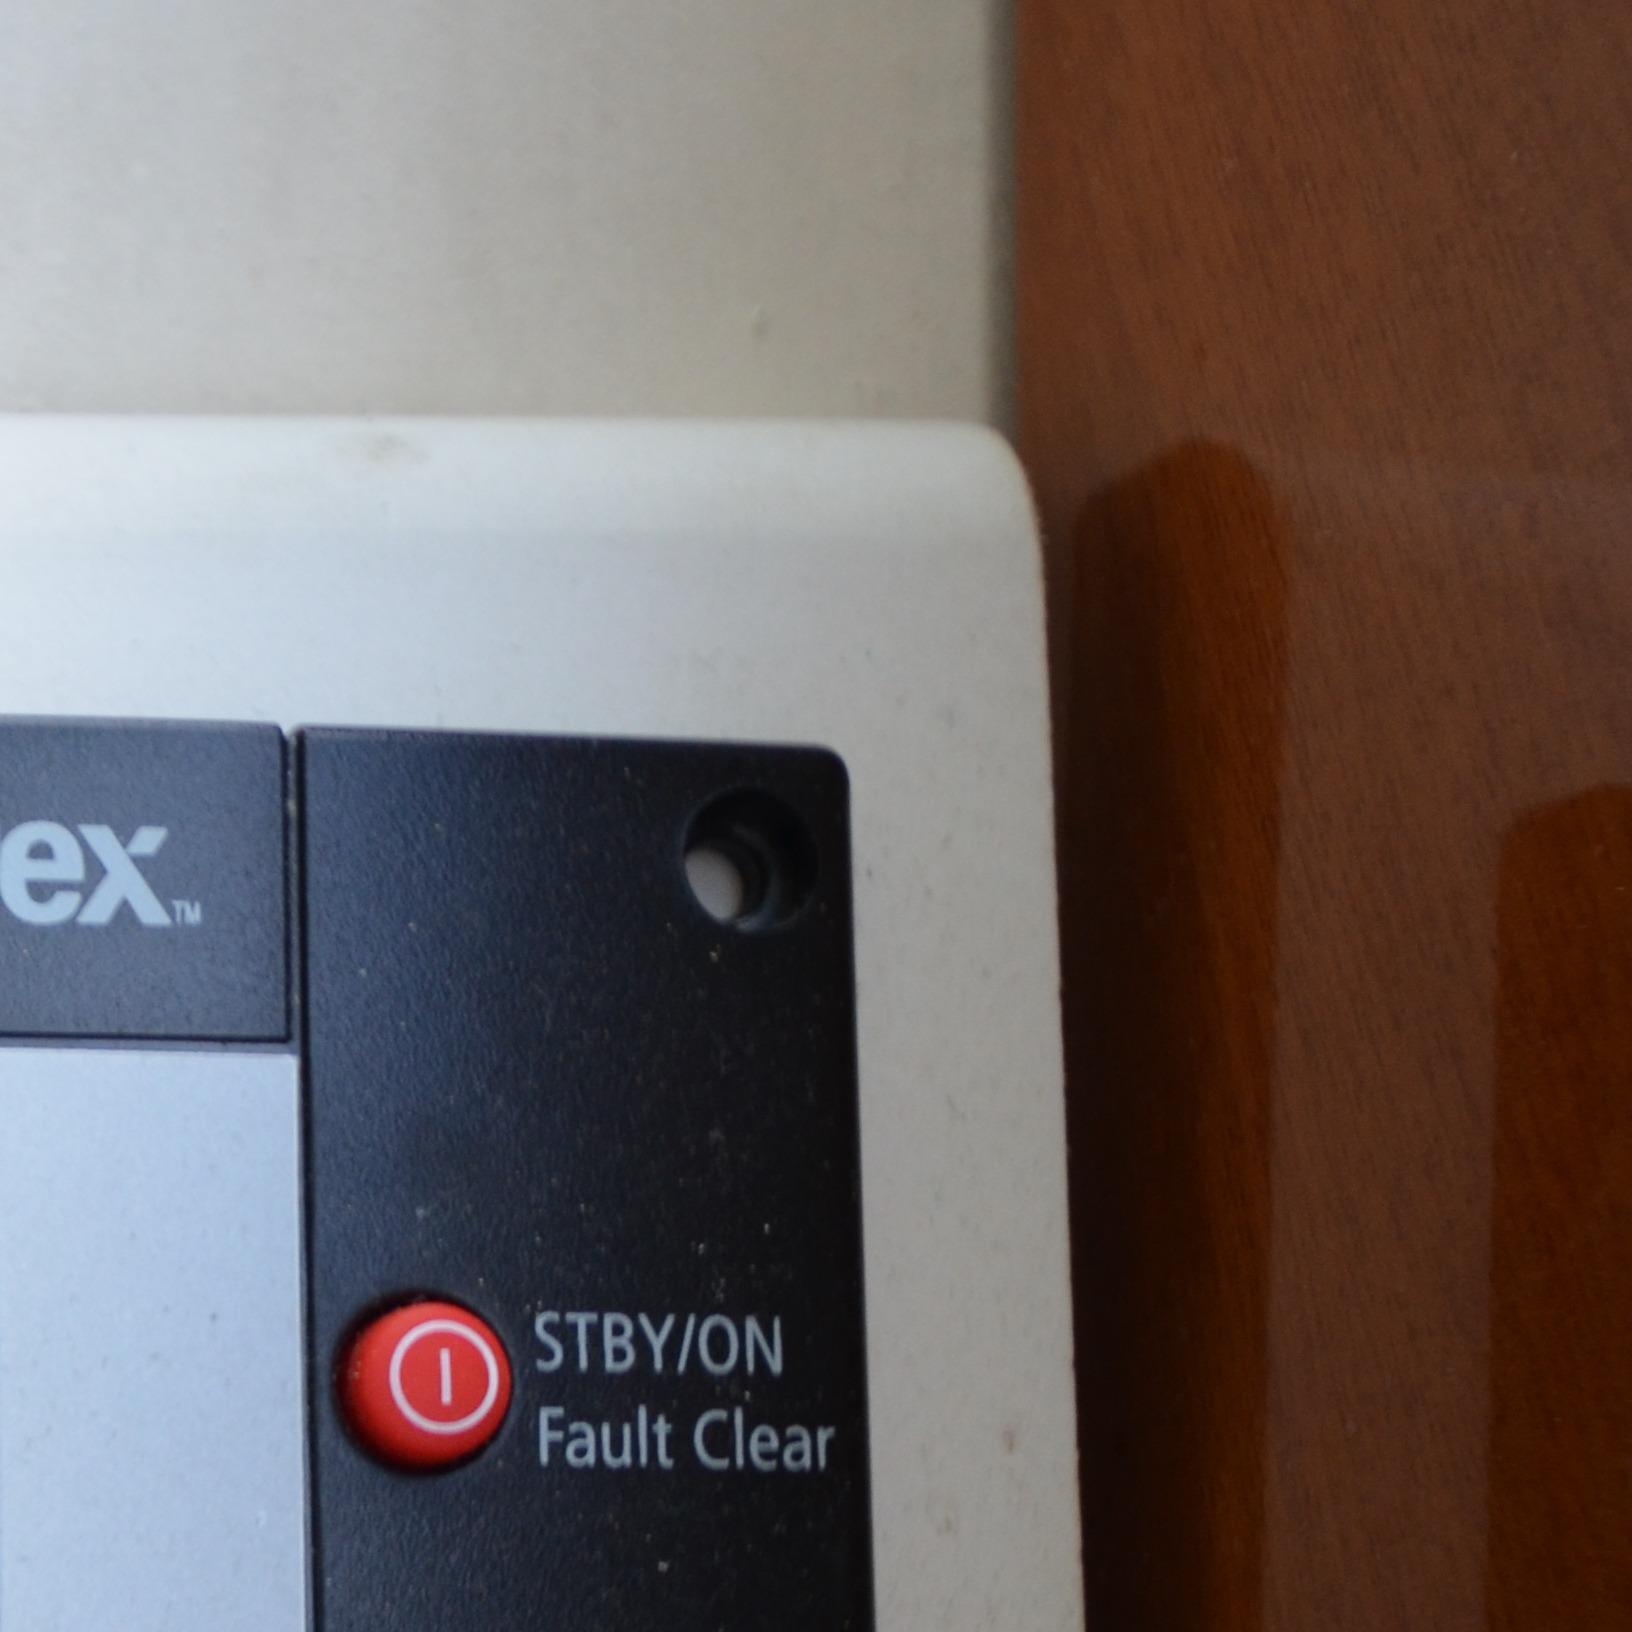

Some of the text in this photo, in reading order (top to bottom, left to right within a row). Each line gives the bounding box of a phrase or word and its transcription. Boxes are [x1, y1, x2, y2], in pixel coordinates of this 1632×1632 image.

[534, 1309, 784, 1376] STBY/ON
[537, 1404, 836, 1470] Fault Clear
